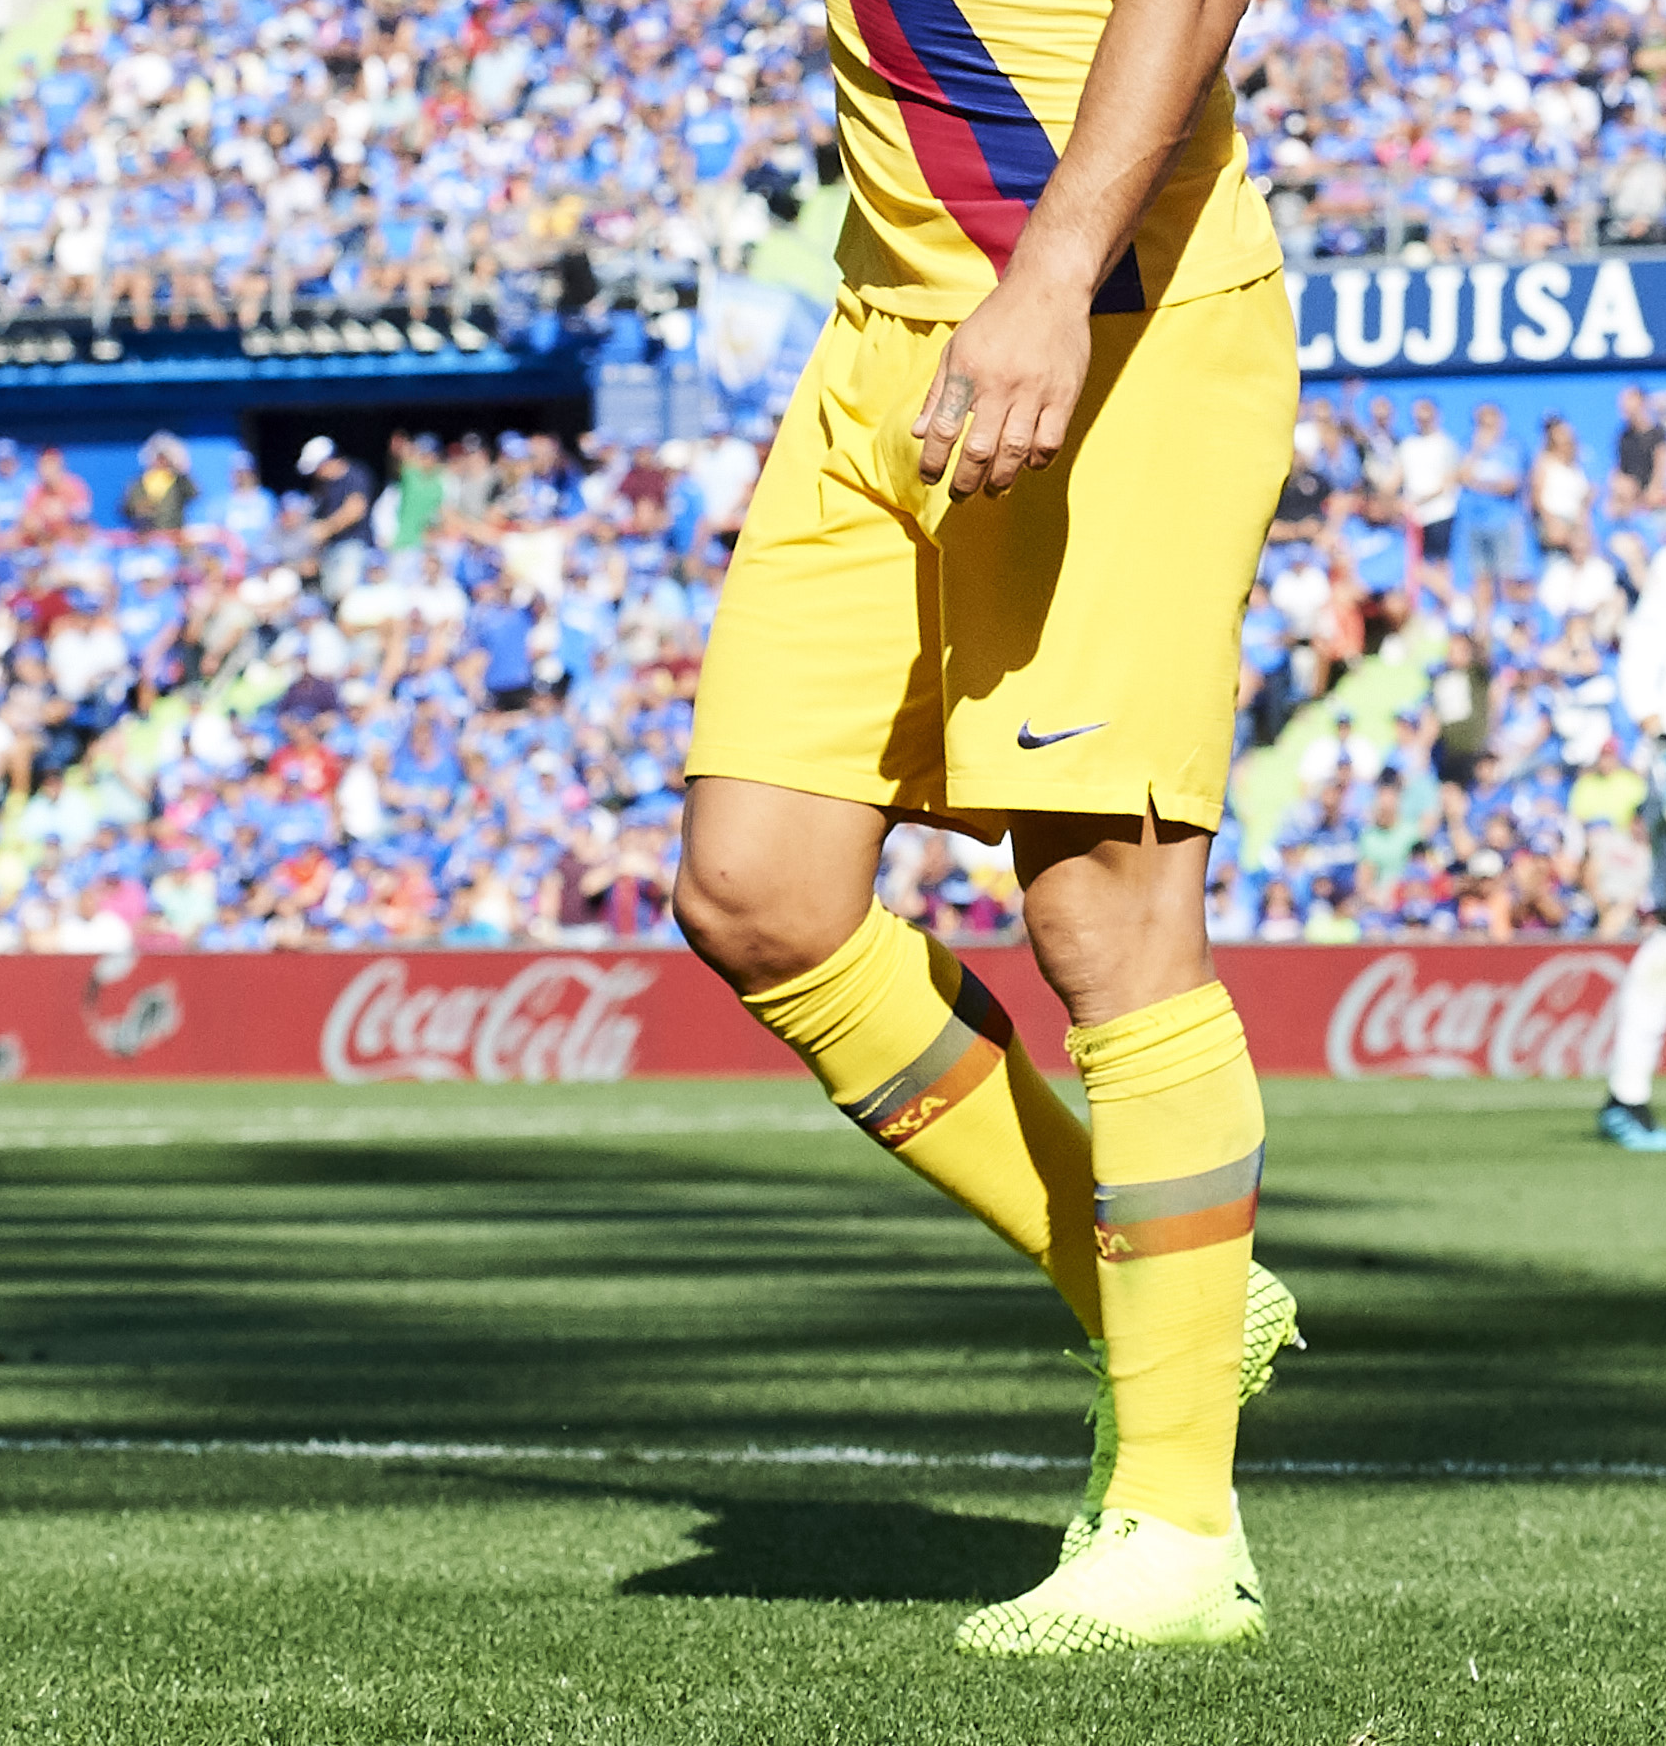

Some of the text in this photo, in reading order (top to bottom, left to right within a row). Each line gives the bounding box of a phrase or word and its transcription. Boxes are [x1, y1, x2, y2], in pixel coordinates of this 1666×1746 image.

[1297, 259, 1655, 371] LUJISA
[319, 956, 659, 1085] Coca-Cola
[1325, 950, 1631, 1082] Coca-Col
